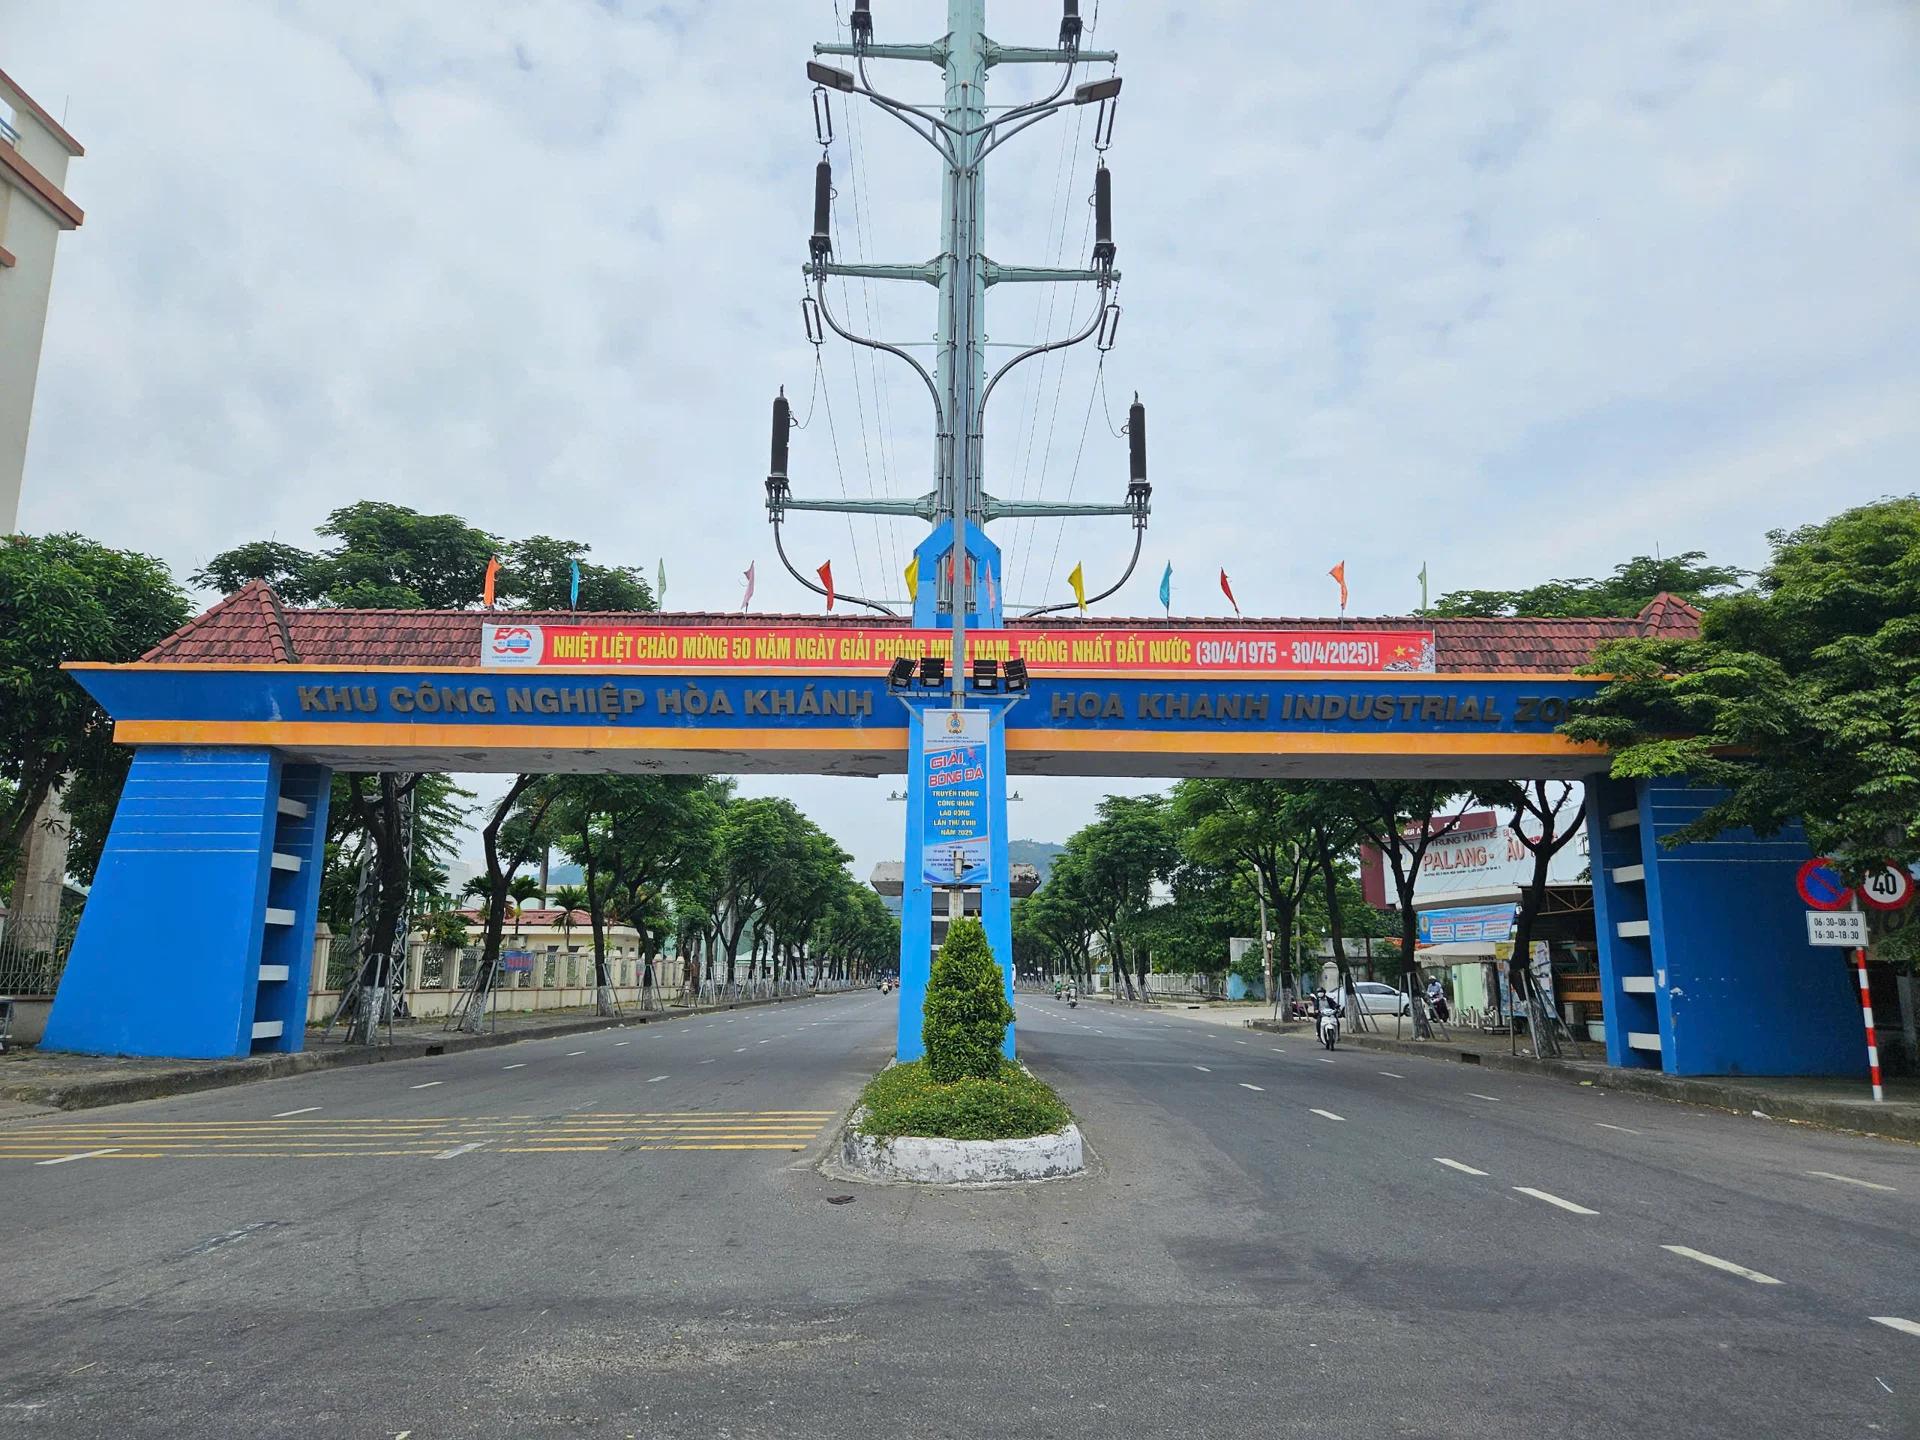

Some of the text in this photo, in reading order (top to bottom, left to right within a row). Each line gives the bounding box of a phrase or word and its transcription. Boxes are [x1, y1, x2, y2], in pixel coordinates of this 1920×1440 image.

[553, 631, 598, 663] NHIỆT
[602, 631, 633, 663] LIỆT
[637, 632, 678, 659] CHÀO
[682, 633, 728, 660] MỪNG
[732, 637, 750, 659] 50
[755, 633, 790, 659] NĂM
[795, 633, 836, 660] NGÀY
[840, 631, 870, 660] GIẢI
[875, 634, 926, 661] PHÓNG
[1018, 633, 1068, 663] THỐNG
[1072, 633, 1113, 663] NHẤT
[1116, 633, 1145, 663] ĐẤT
[1150, 636, 1192, 664] NƯỚC
[1196, 641, 1277, 666] (30/4/1975
[1291, 641, 1379, 666] 30/4/2025)!
[297, 681, 874, 721] KHU CÔNG NGHIỆP HÒA KHÁNH
[1051, 692, 1125, 719] HOA
[1137, 693, 1270, 720] KHANH
[1281, 694, 1503, 722] INDUSTRIAL
[1423, 846, 1488, 872] PALANG
[1872, 873, 1897, 895] 40
